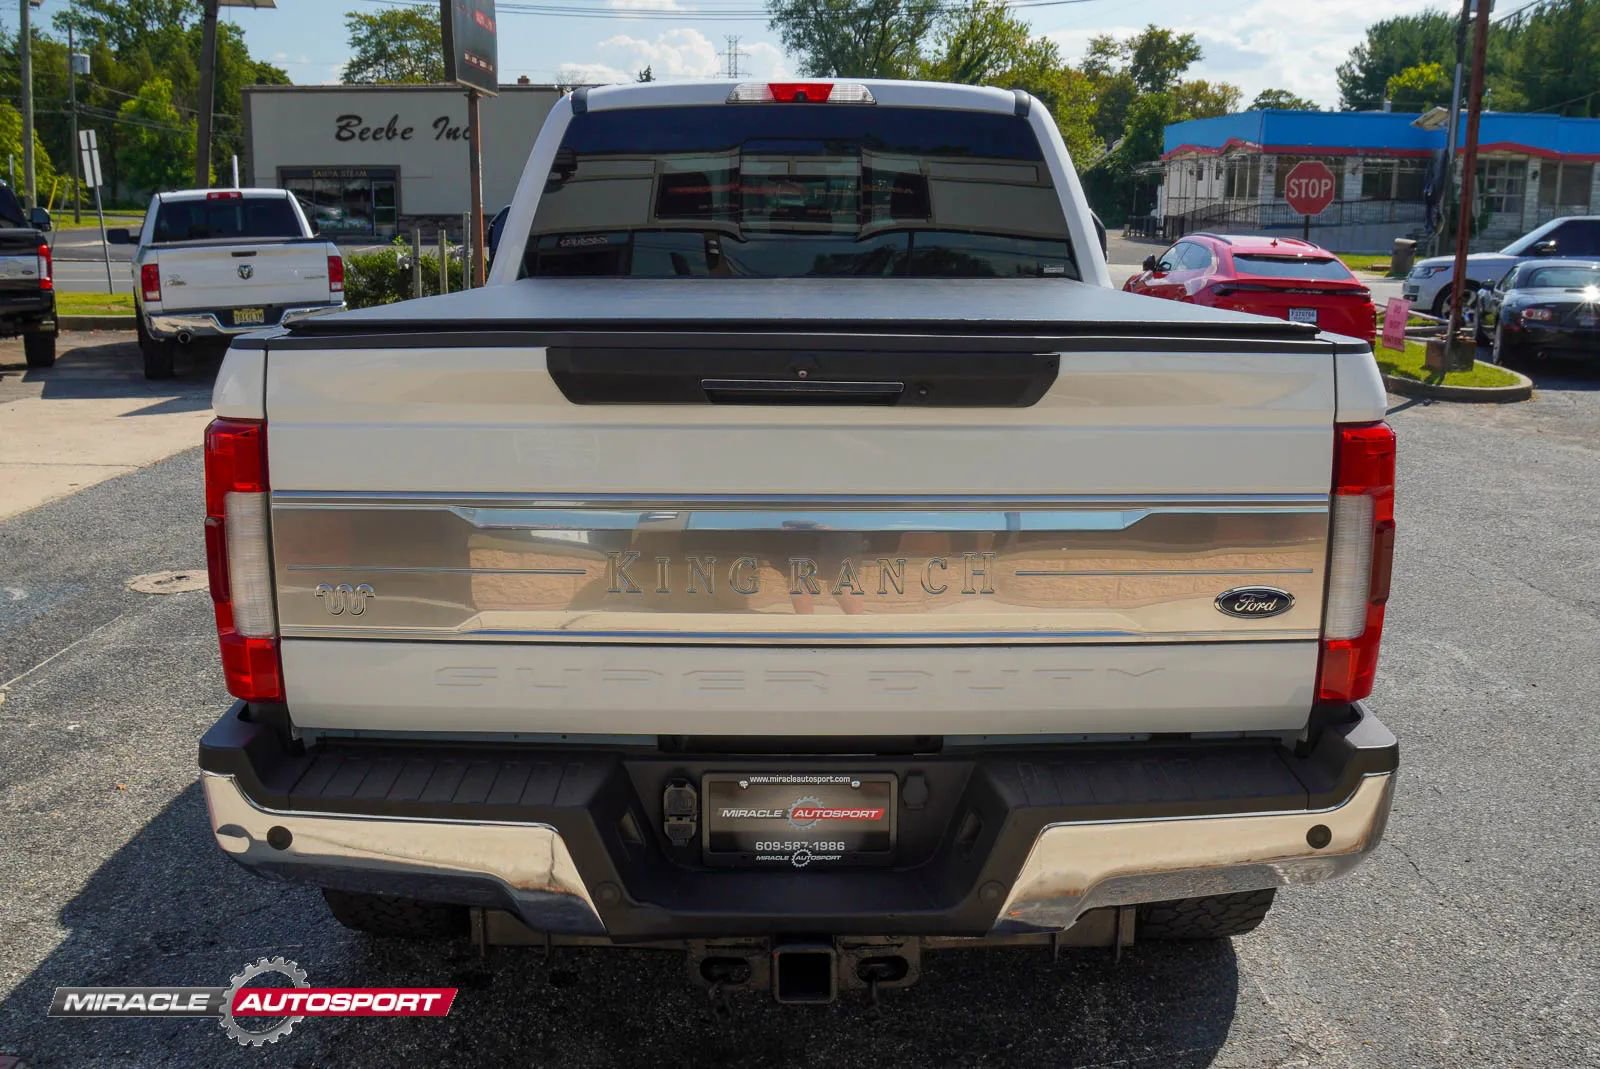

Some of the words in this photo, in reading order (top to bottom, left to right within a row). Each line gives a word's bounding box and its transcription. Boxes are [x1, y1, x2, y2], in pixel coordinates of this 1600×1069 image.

[335, 114, 414, 142] Beebe
[1289, 178, 1332, 198] STOP
[606, 551, 761, 595] KING
[788, 551, 997, 596] RANCH
[1234, 592, 1280, 612] Ford
[434, 665, 829, 692] SUPER
[749, 774, 851, 785] www.miracleautosport.com
[721, 808, 784, 818] MIRACLE
[793, 808, 880, 818] AUTOSPORT
[755, 840, 846, 852] 609-587-1986
[755, 854, 790, 862] MIRACLE
[794, 854, 842, 862] AUTOSPORT
